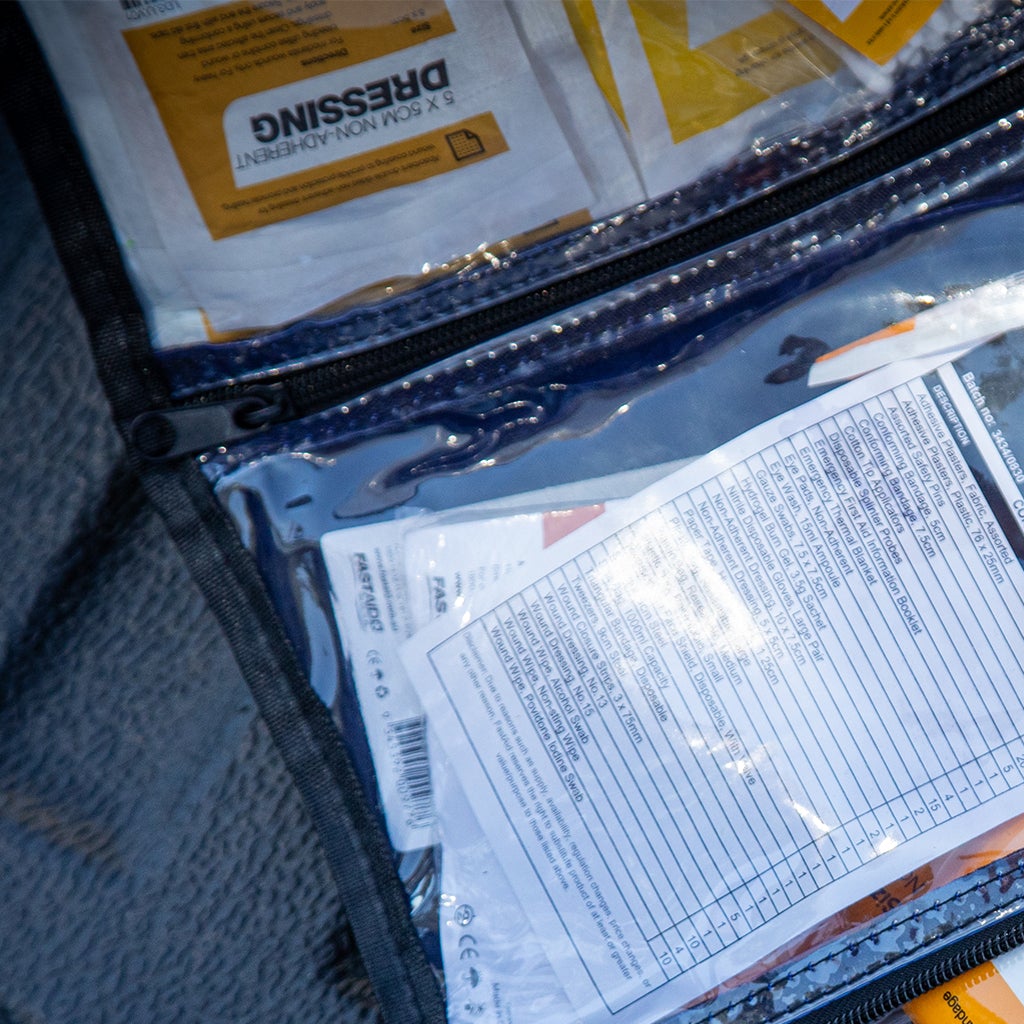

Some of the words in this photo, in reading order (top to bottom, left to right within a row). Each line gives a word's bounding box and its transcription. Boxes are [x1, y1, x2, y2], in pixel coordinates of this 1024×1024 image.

[252, 60, 450, 144] DRESSING
[378, 100, 422, 127] 5CM
[423, 94, 440, 111] X
[441, 89, 454, 104] 5
[233, 110, 377, 172] NON-ADHERENT
[930, 382, 971, 446] DESCRIPTION
[960, 370, 987, 407] Batch
[978, 405, 997, 428] no:
[841, 423, 868, 461] Cotton
[858, 458, 877, 479] Tip
[885, 404, 918, 451] Assorted
[907, 448, 935, 485] Safety
[927, 482, 948, 508] Pins
[824, 431, 864, 490] Disposable
[853, 486, 886, 530] Splinter
[877, 526, 905, 565] Probes
[867, 475, 907, 535] Applicators
[869, 410, 911, 472] Conforming
[928, 517, 948, 542] 5cm
[914, 390, 948, 439] Adhesive
[982, 517, 1016, 565] Assorted
[782, 453, 802, 475] Eye
[810, 504, 855, 576] Non-Adherent
[810, 438, 850, 498] Emergency
[842, 495, 863, 521] First
[855, 518, 873, 539] Aid
[864, 537, 903, 596] Information
[895, 594, 924, 636] Booklet
[828, 502, 858, 546] Thermal
[850, 544, 879, 586] Blanket
[981, 550, 1006, 585] 25mm
[553, 582, 582, 622] Wound
[557, 628, 593, 679] Dressing,
[584, 676, 609, 709] No.13
[533, 684, 568, 735] Non-sting
[548, 675, 576, 715] Alcohol
[567, 714, 591, 746] Swab
[570, 685, 595, 718] No.15
[520, 692, 554, 742] Povidone
[545, 739, 571, 775] Iodine
